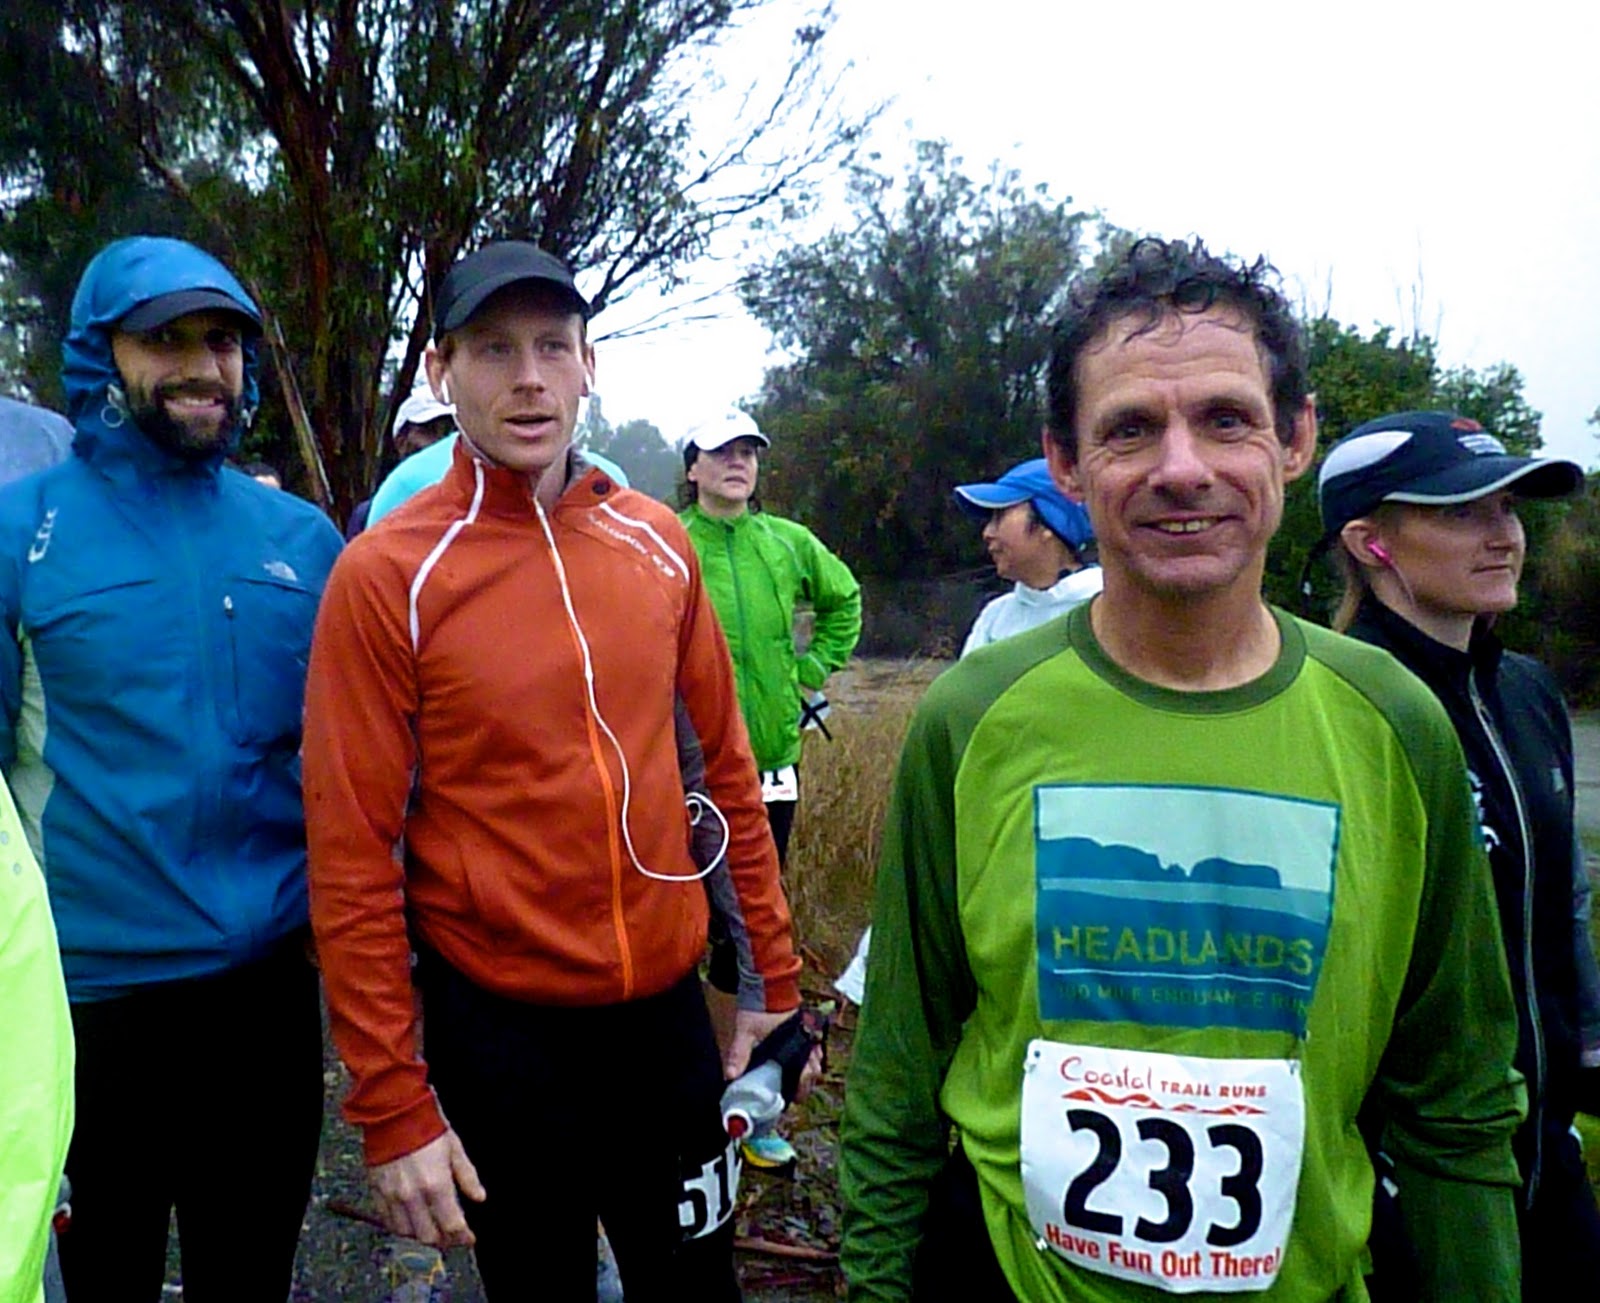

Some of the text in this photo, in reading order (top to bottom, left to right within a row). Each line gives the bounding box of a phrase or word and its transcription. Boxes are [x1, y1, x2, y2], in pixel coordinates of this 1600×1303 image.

[1053, 925, 1314, 976] HEADLANDS
[1060, 1056, 1266, 1099] Coastal TRAIL RUNS
[1064, 1108, 1264, 1248] 233
[1046, 1223, 1280, 1279] Have Fun Out There!
